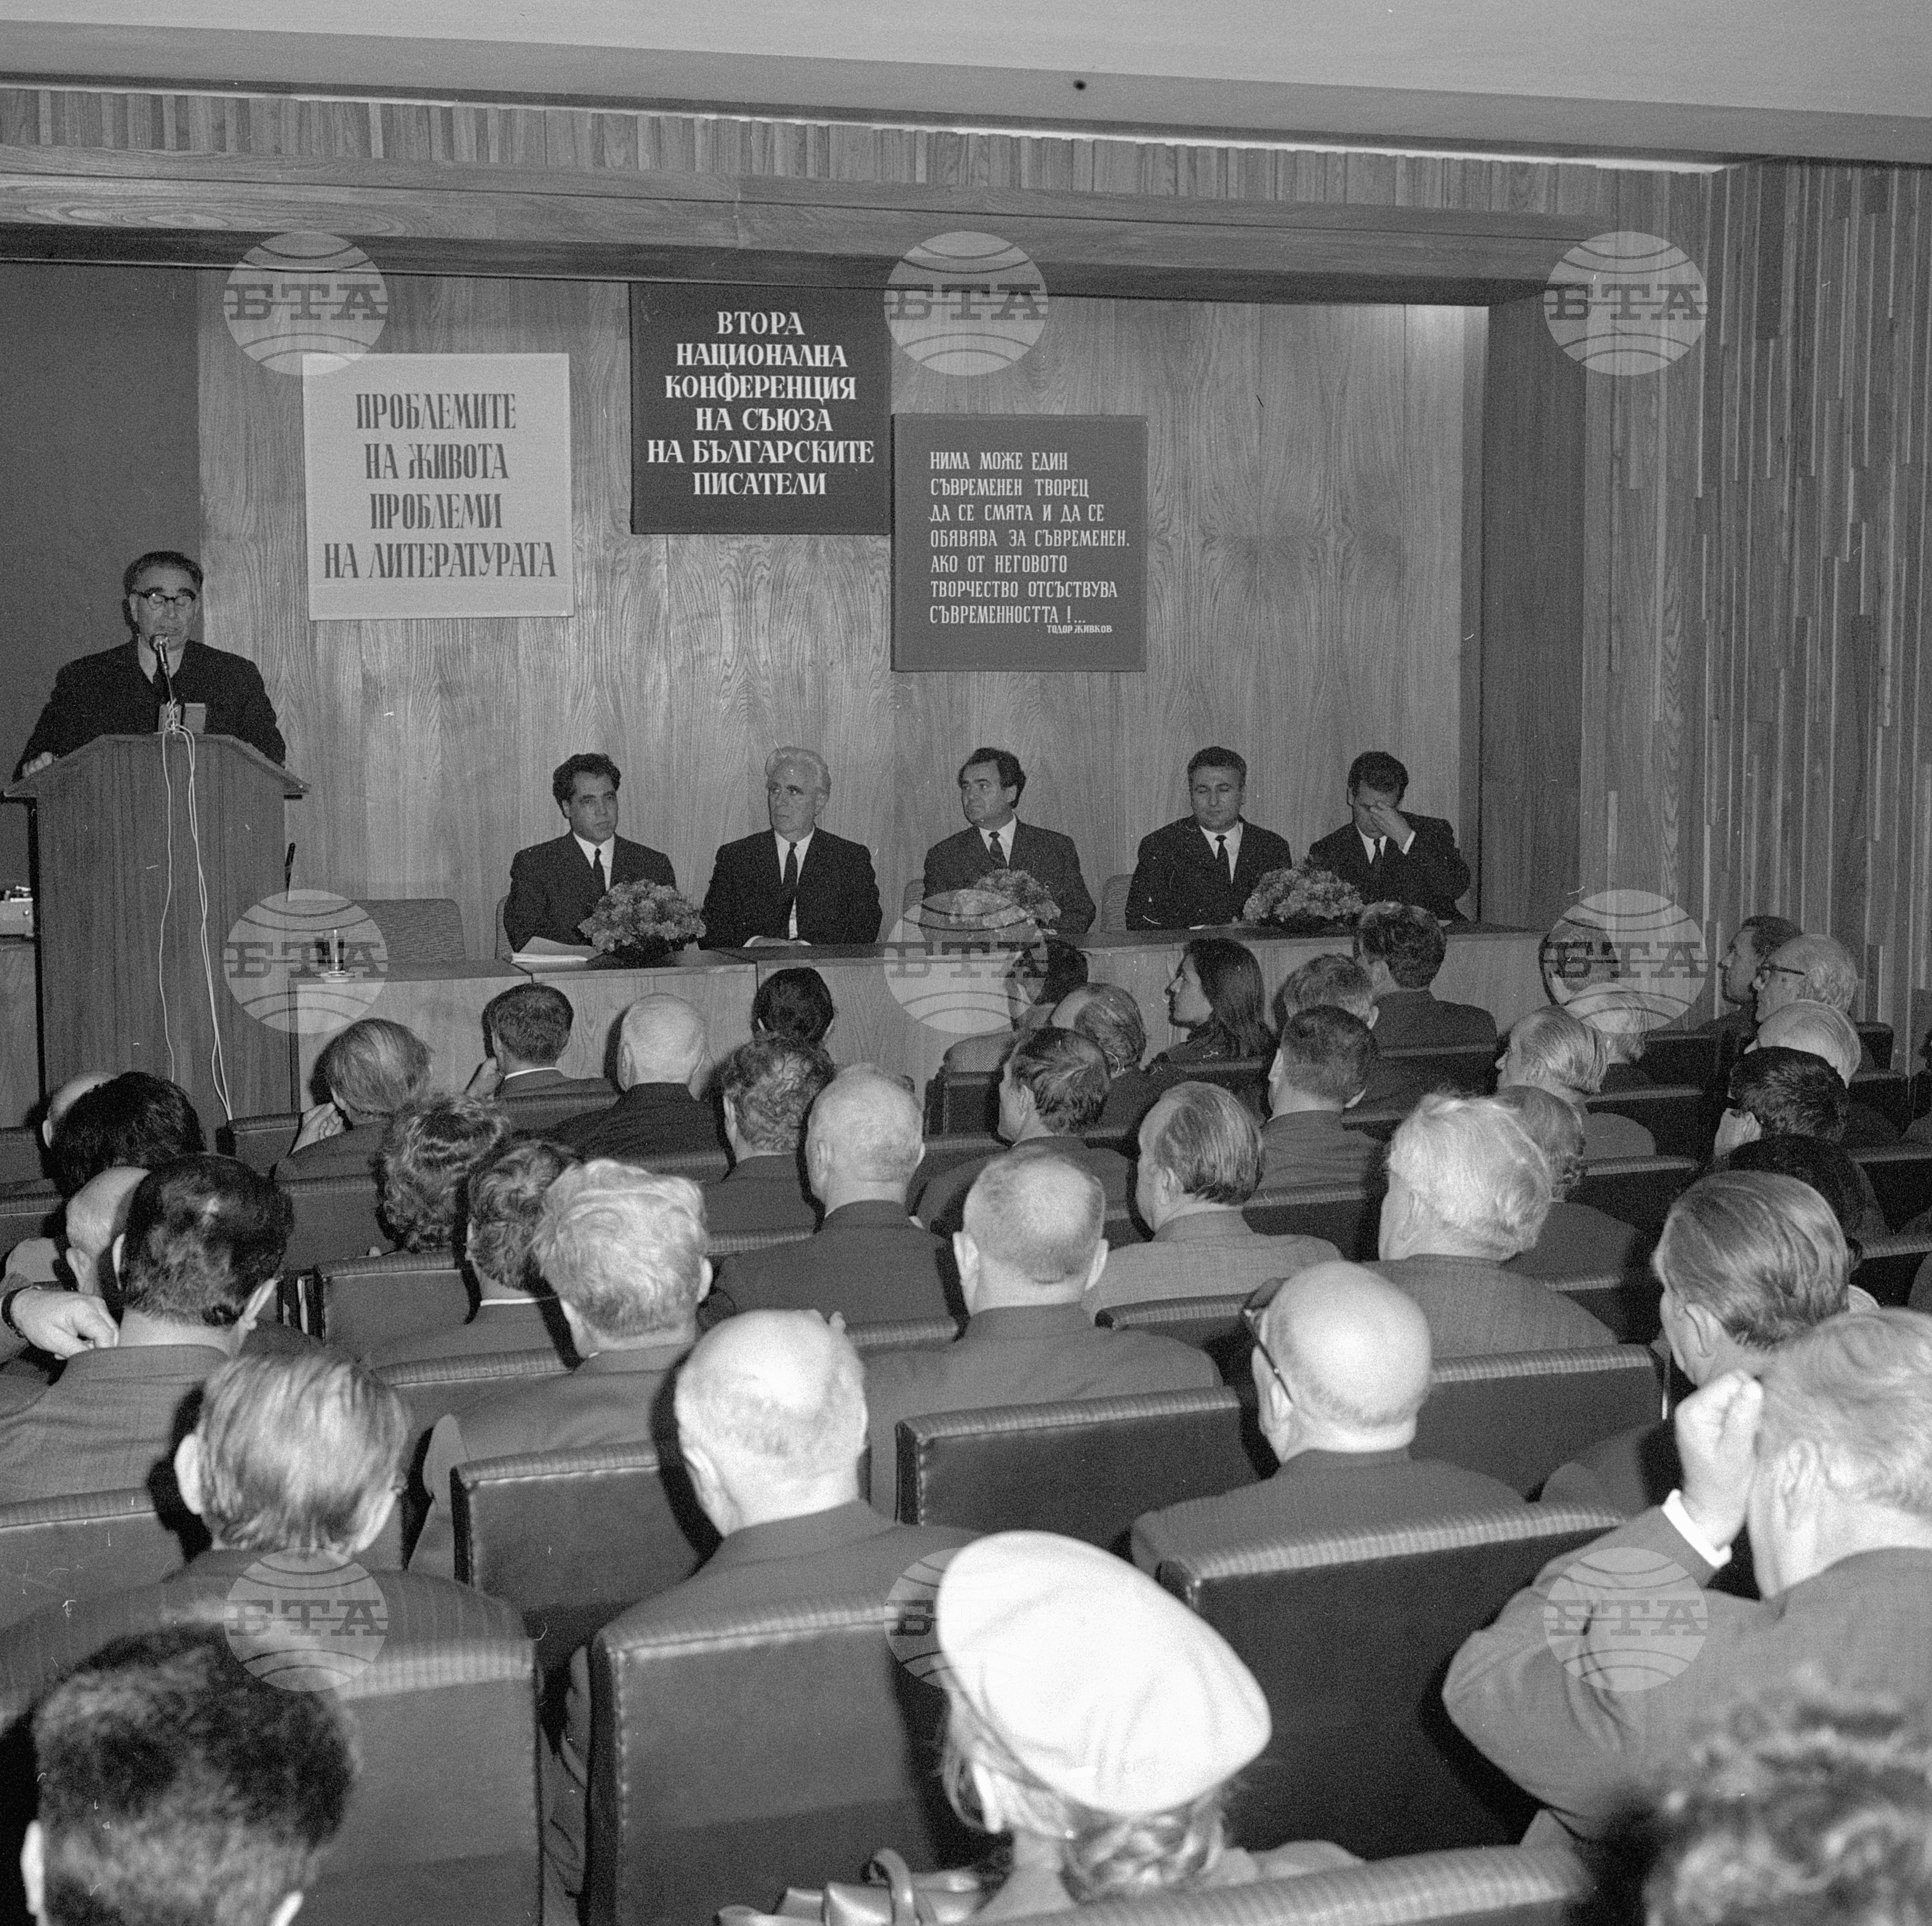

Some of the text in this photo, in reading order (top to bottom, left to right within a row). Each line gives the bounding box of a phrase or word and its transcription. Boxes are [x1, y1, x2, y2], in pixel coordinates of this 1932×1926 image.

[716, 312, 805, 335] ВТОРА
[676, 343, 848, 369] НАЦИОНАЛНА
[665, 372, 857, 405] КОНФЕРЕНЦИЯ
[355, 393, 516, 429] ПРОБЛЕМИТЕ
[696, 408, 833, 431] НА СЪЮЗА
[364, 443, 509, 479] НА ЖИВОТА
[647, 440, 874, 464] НА БЪЛГАРСКИТЕ
[930, 452, 1068, 471] НИМА МОЖЕ ЕДИН
[693, 472, 827, 495] ПИСАТЕЛИ
[930, 478, 1089, 498] СЪВРЕМЕНЕН ТВОРЕЦ
[370, 493, 502, 529] ПРОБЛЕМИ
[929, 504, 1104, 523] ДА СЕ СМЯТА И ДА СЕ
[930, 529, 998, 547] ОБЯВЯВА
[1009, 529, 1026, 547] ЗА
[324, 542, 558, 579] НА ЛИТЕРАТУРАТА
[930, 555, 1068, 573] АКО ОТ НЕГОВОТО
[930, 581, 1118, 598] ТВОРЧЕСТВО ОТСЪСТВУВА
[930, 606, 1058, 624] СЪВРЕМЕННОСТТА
[1047, 625, 1112, 634] ТОДОР ЖИВКОВ
